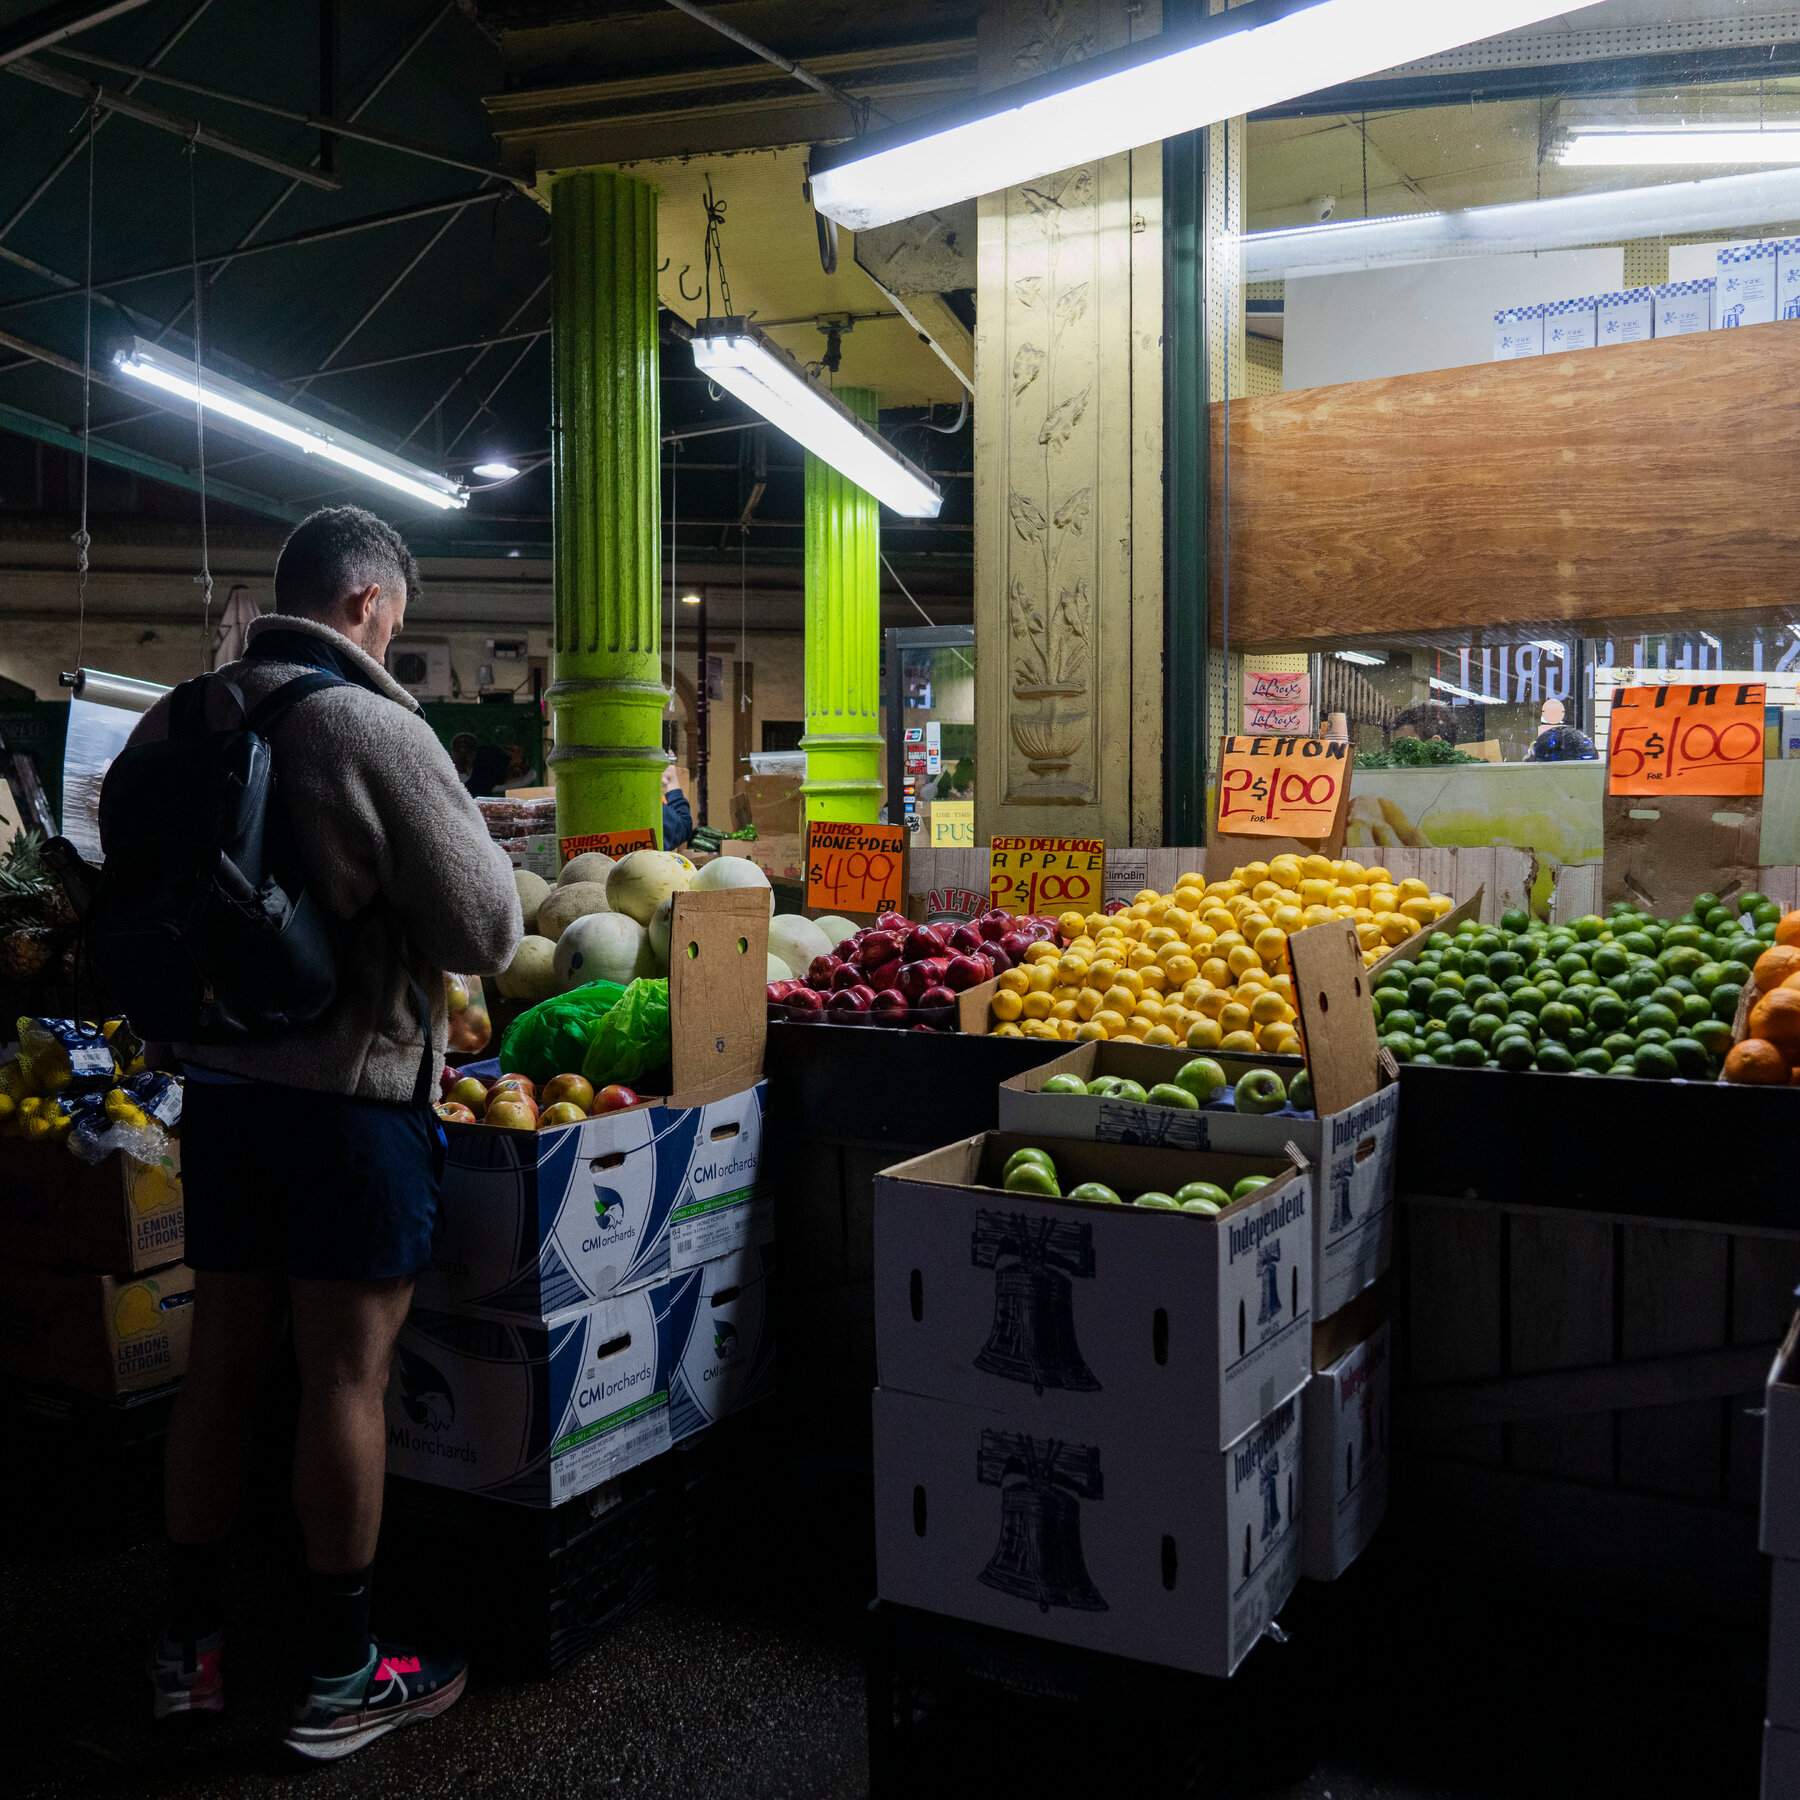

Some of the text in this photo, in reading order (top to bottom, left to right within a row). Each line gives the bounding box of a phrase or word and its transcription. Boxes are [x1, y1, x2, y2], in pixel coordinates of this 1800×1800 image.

[1251, 677, 1299, 698] LaCroix
[1612, 684, 1765, 709] LIME
[1251, 709, 1298, 729] LaCroix
[1225, 737, 1346, 760] LEMON
[1612, 726, 1648, 778] 5
[1221, 769, 1255, 818] 2
[812, 822, 863, 836] JUMBO
[1250, 815, 1266, 823] FOR
[563, 834, 609, 849] JUMBO
[812, 835, 903, 853] HONEYDEW
[992, 837, 1103, 854] RED DELICIOUS
[993, 852, 1102, 871] APPLE
[1105, 870, 1145, 880] limaBin
[1332, 1091, 1396, 1154] Independent
[694, 1152, 757, 1183] CMI orchards
[137, 1211, 183, 1236] LEMONS
[1229, 1186, 1304, 1265] Independent
[138, 1225, 185, 1250] CITRONS
[582, 1227, 635, 1252] CMI orchards
[117, 1336, 169, 1362] LEMONS
[117, 1349, 171, 1375] CITRONS
[703, 1365, 719, 1381] CMI
[579, 1363, 651, 1408] CMI orchards
[389, 1426, 477, 1464] MI orchards
[581, 1434, 616, 1455] HONEYCRISP
[1234, 1396, 1295, 1493] Independent
